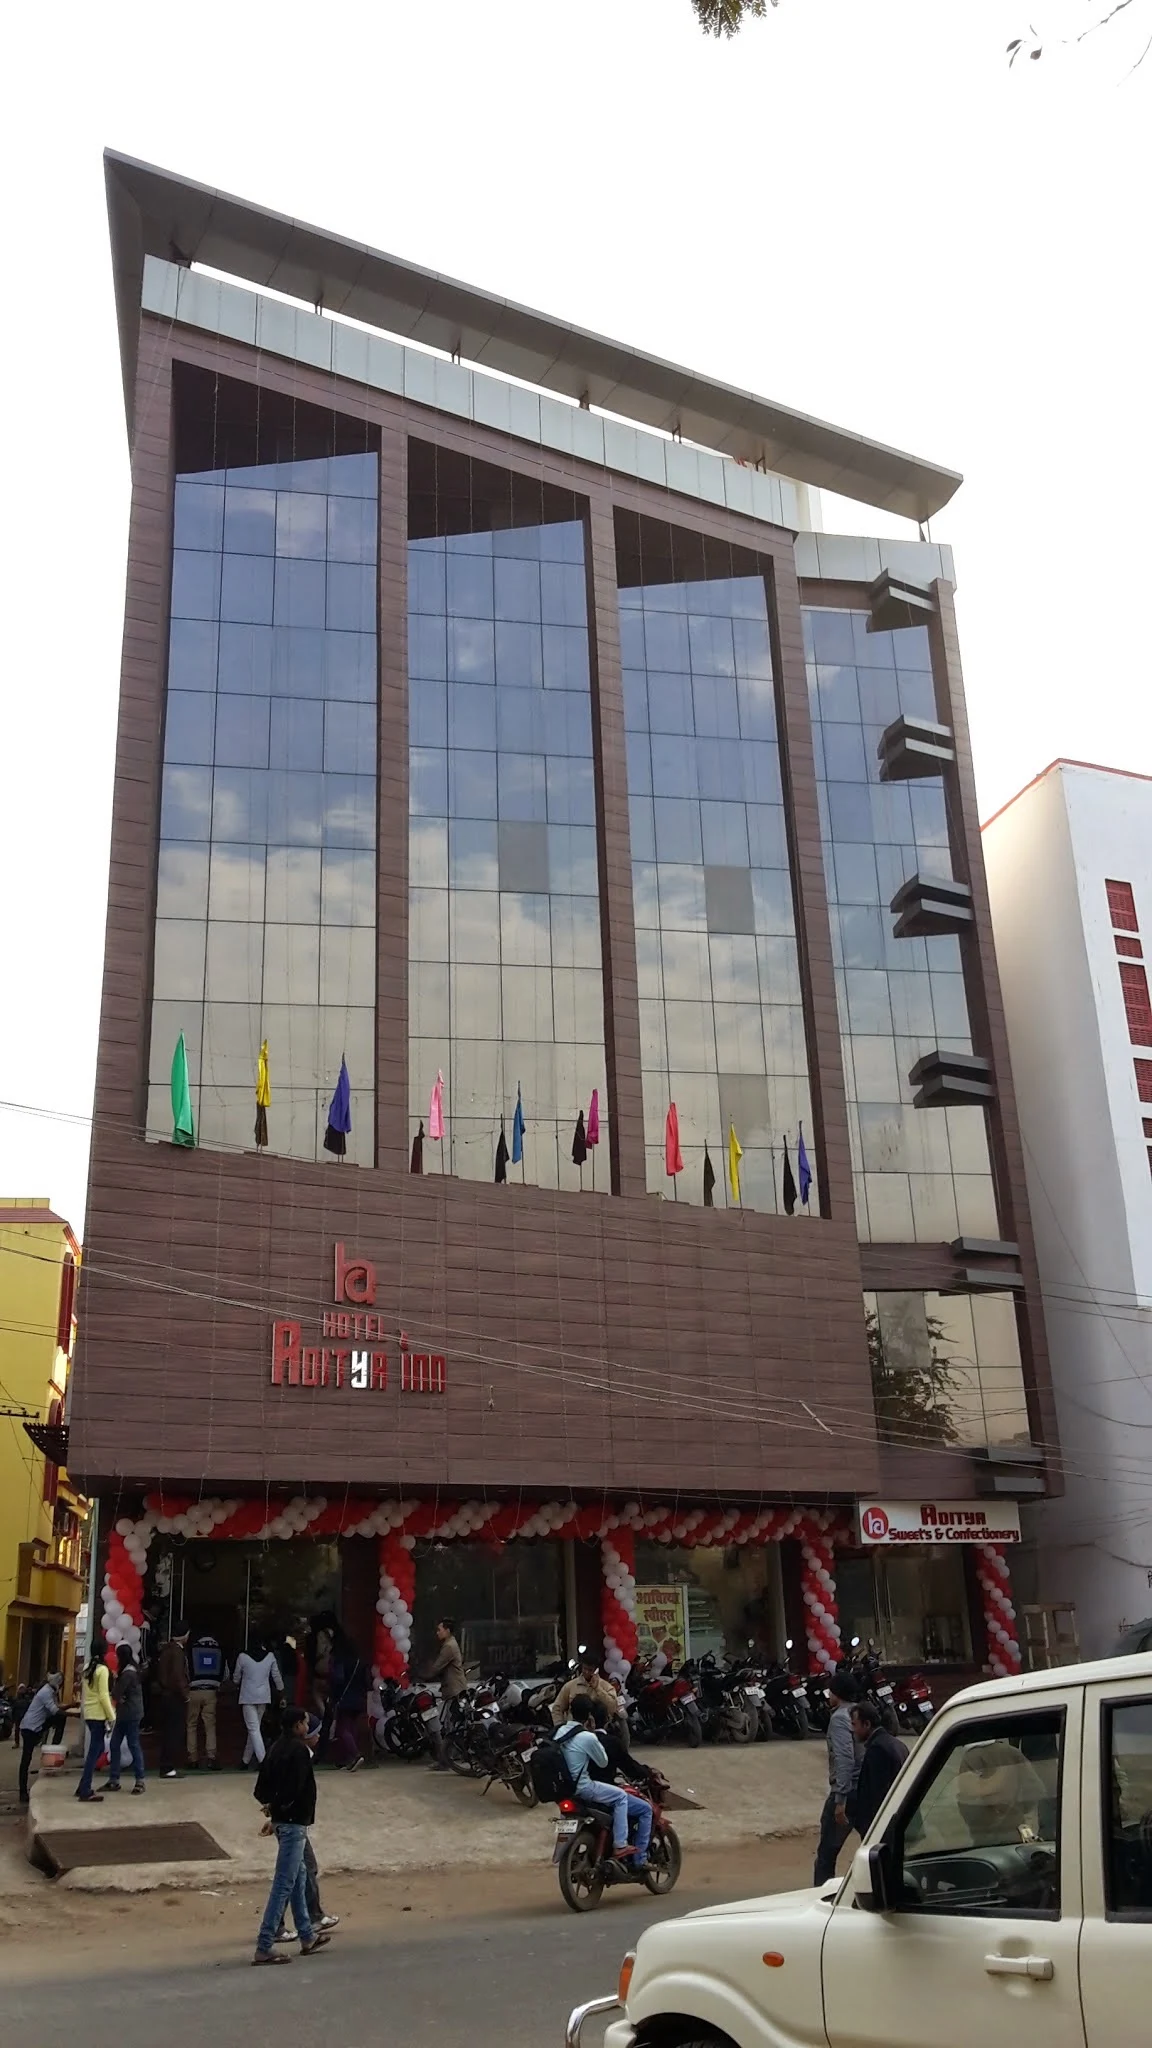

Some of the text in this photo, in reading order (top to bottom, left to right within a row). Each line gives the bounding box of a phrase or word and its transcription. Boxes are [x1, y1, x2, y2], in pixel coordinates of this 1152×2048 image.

[322, 1311, 388, 1342] HOTEL
[935, 1528, 944, 1541] &
[946, 1528, 1020, 1542] Confectionery
